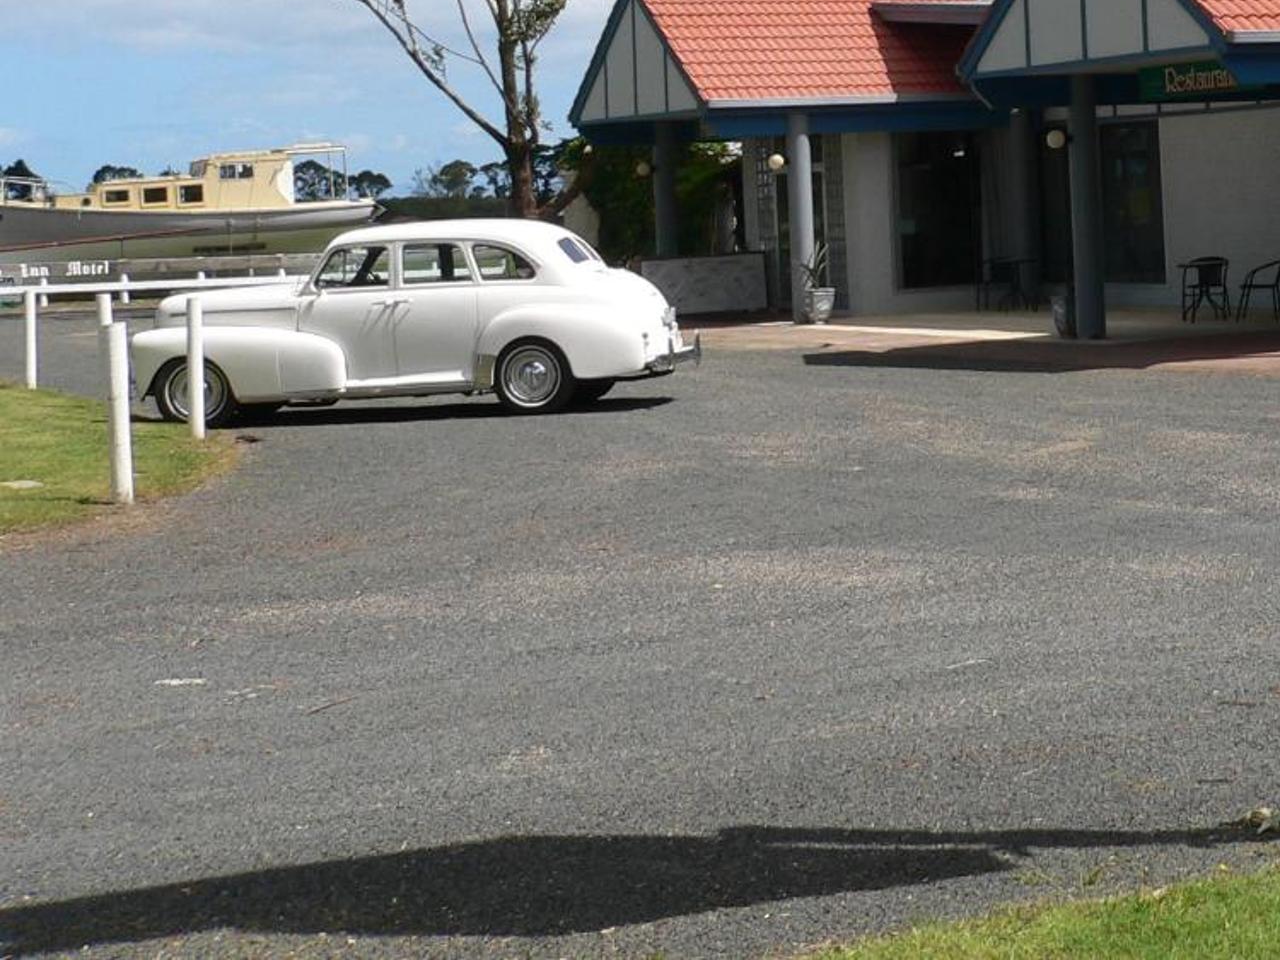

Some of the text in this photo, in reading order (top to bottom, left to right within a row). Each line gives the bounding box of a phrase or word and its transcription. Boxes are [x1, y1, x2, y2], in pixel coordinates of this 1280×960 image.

[1164, 66, 1234, 93] Restauran
[20, 260, 109, 278] Inn Motel
